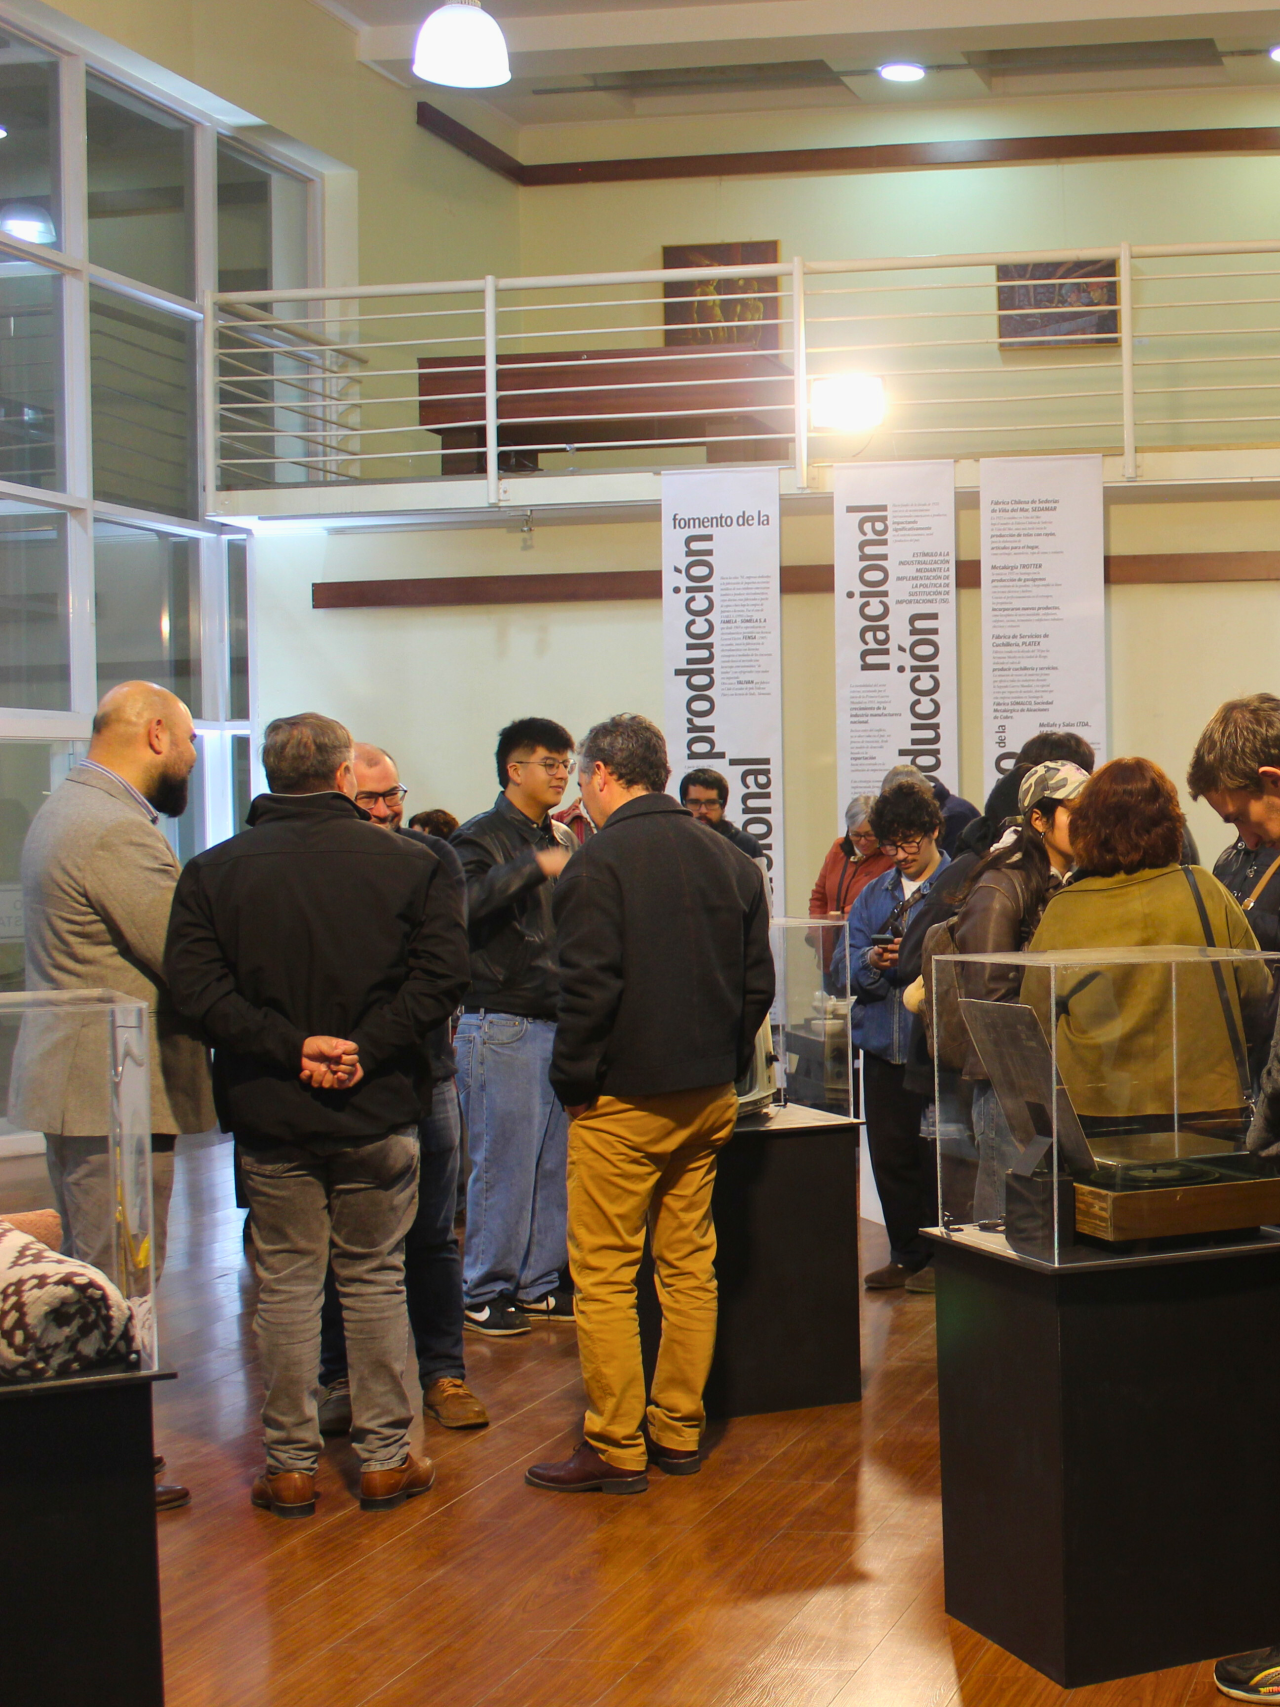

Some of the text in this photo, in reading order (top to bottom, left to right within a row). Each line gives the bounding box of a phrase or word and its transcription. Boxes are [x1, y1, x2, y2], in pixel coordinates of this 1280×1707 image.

[673, 510, 770, 530] fomento de la
[896, 574, 942, 582] IMPLEMENTACIÓN
[673, 534, 726, 760] producción
[846, 504, 890, 671] nacional
[897, 612, 942, 785] ducción
[995, 724, 1006, 748] de la
[729, 758, 773, 890] onal
